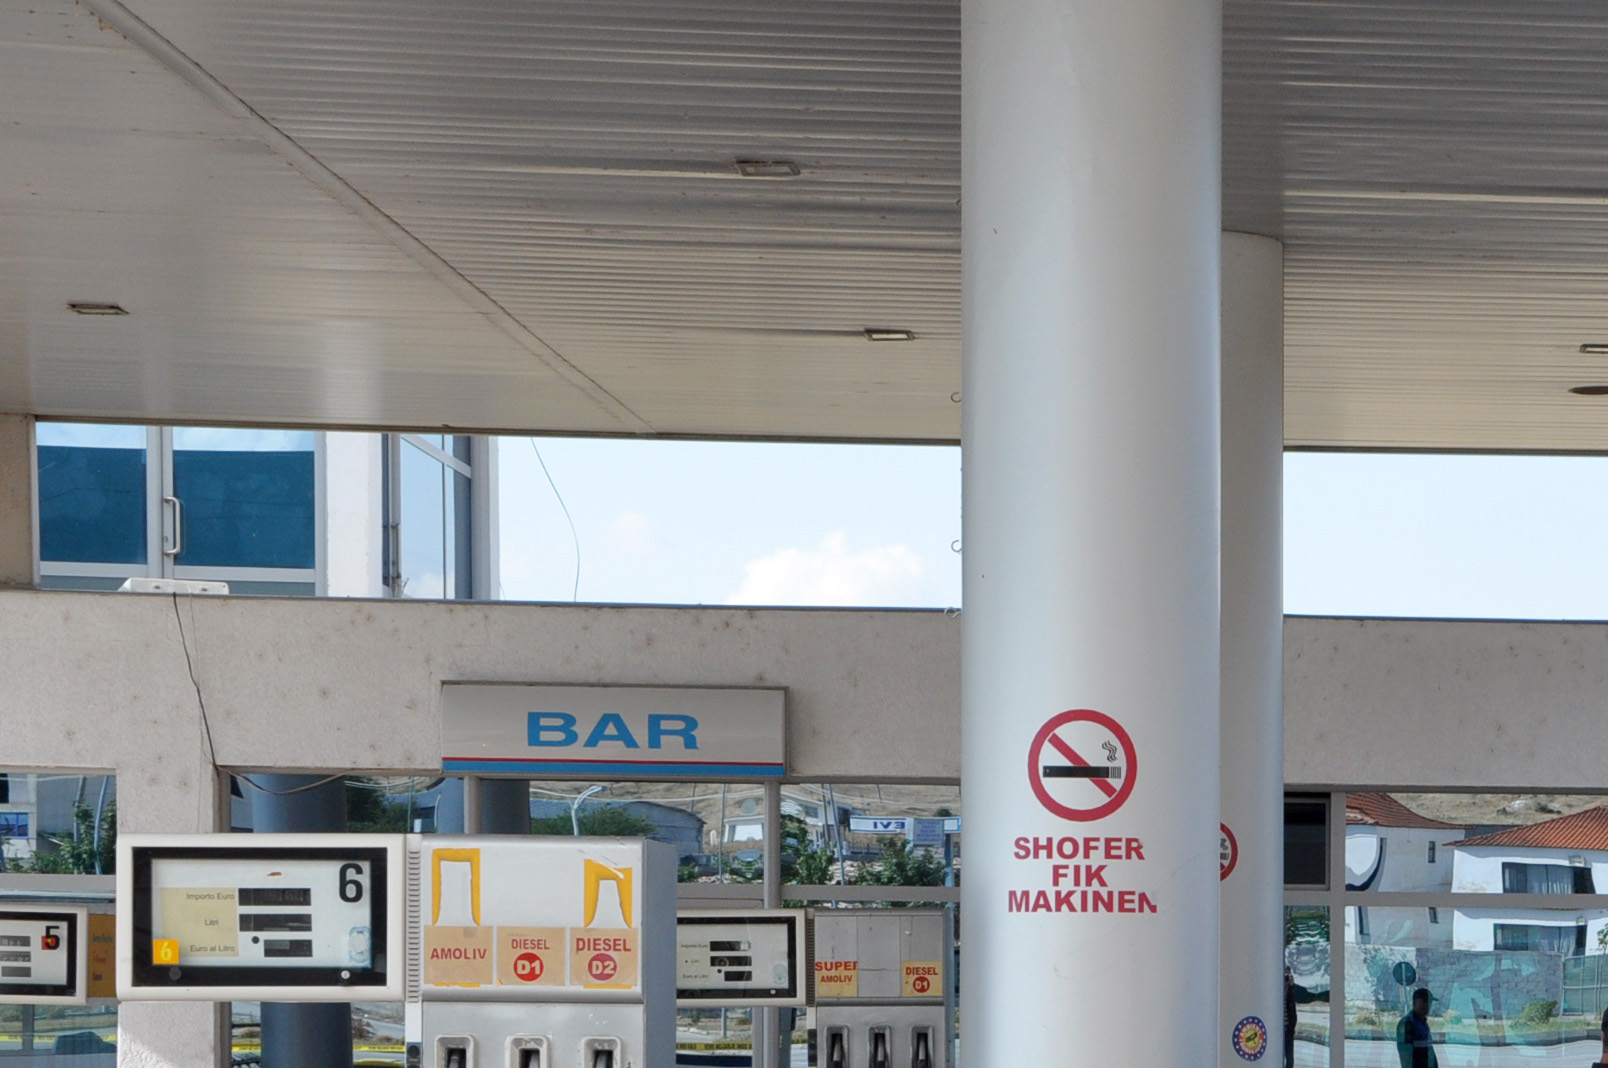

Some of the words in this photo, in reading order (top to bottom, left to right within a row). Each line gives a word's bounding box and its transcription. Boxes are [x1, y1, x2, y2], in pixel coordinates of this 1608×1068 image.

[527, 711, 700, 750] BAR
[1013, 836, 1145, 860] SHOFER
[338, 862, 364, 903] 6
[1052, 864, 1109, 887] FIK
[186, 893, 214, 901] Importo
[1008, 890, 1158, 913] MAKINEN
[45, 925, 60, 950] 5
[511, 939, 549, 950] DIESEL
[575, 937, 632, 952] DIESEL
[159, 941, 173, 961] 6
[430, 948, 487, 960] AMOLIV
[516, 960, 541, 974] D1
[591, 961, 615, 974] D2
[905, 967, 938, 975] DIESEL
[820, 975, 853, 983] AMOLIV
[915, 981, 928, 990] D1
